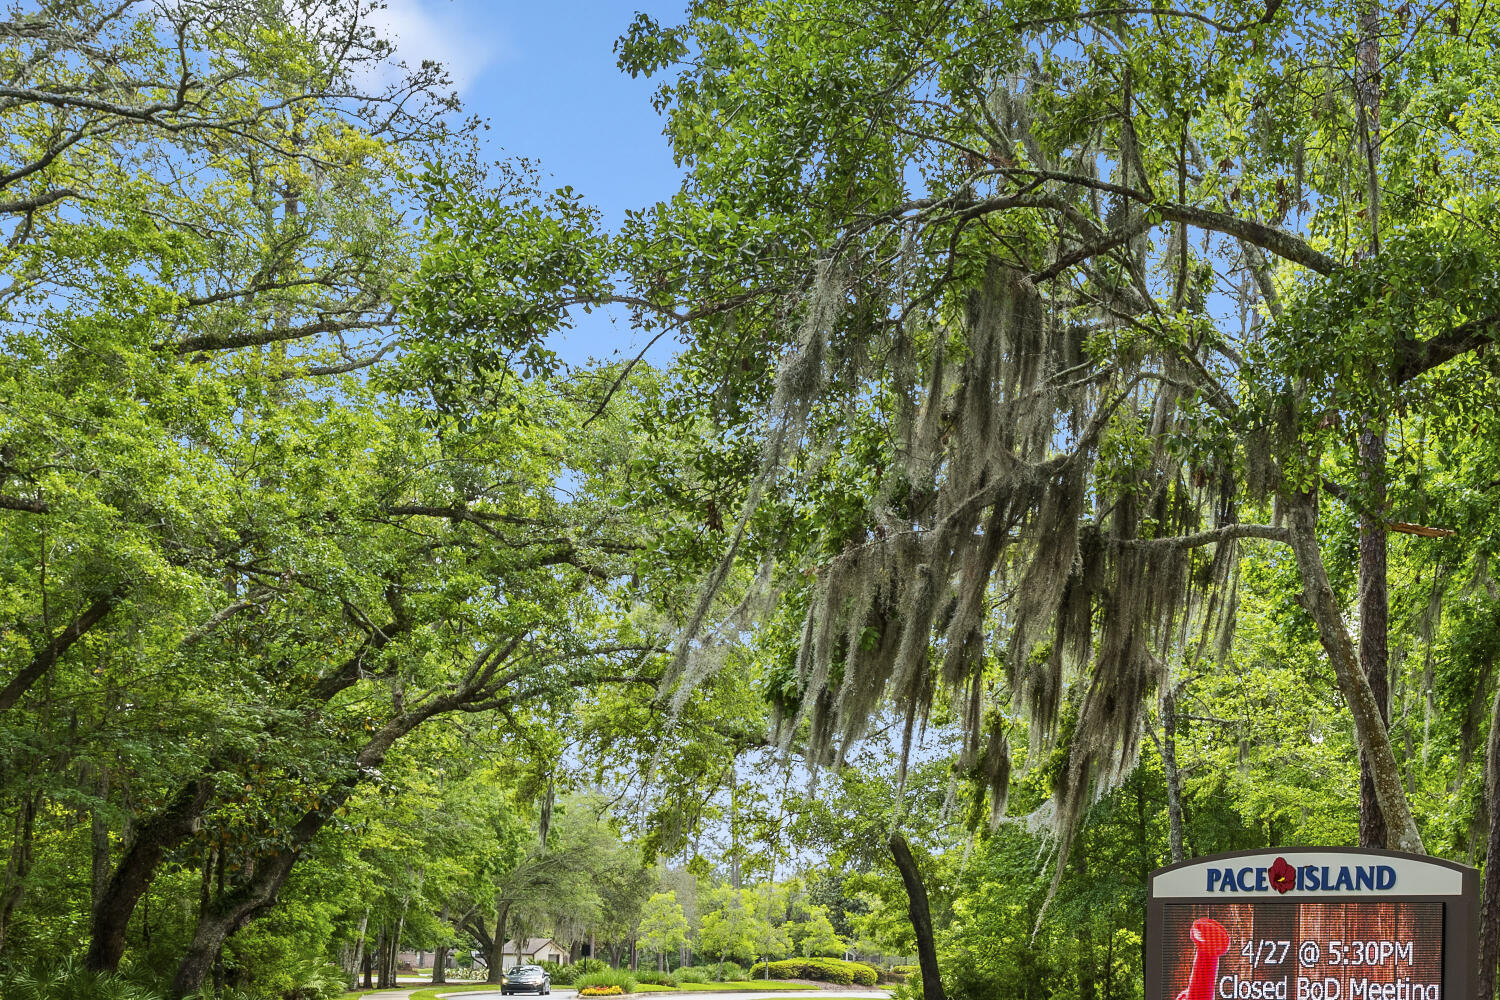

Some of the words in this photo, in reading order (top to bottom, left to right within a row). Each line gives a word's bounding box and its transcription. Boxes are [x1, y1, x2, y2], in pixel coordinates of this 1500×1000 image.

[1206, 866, 1268, 892] PACE
[1296, 865, 1397, 891] ISLAND
[1241, 939, 1290, 968] 4/27
[1299, 943, 1320, 967] @
[1328, 941, 1413, 966] 5:30PM
[1218, 975, 1287, 1000] Closed
[1297, 977, 1340, 1000] BoD
